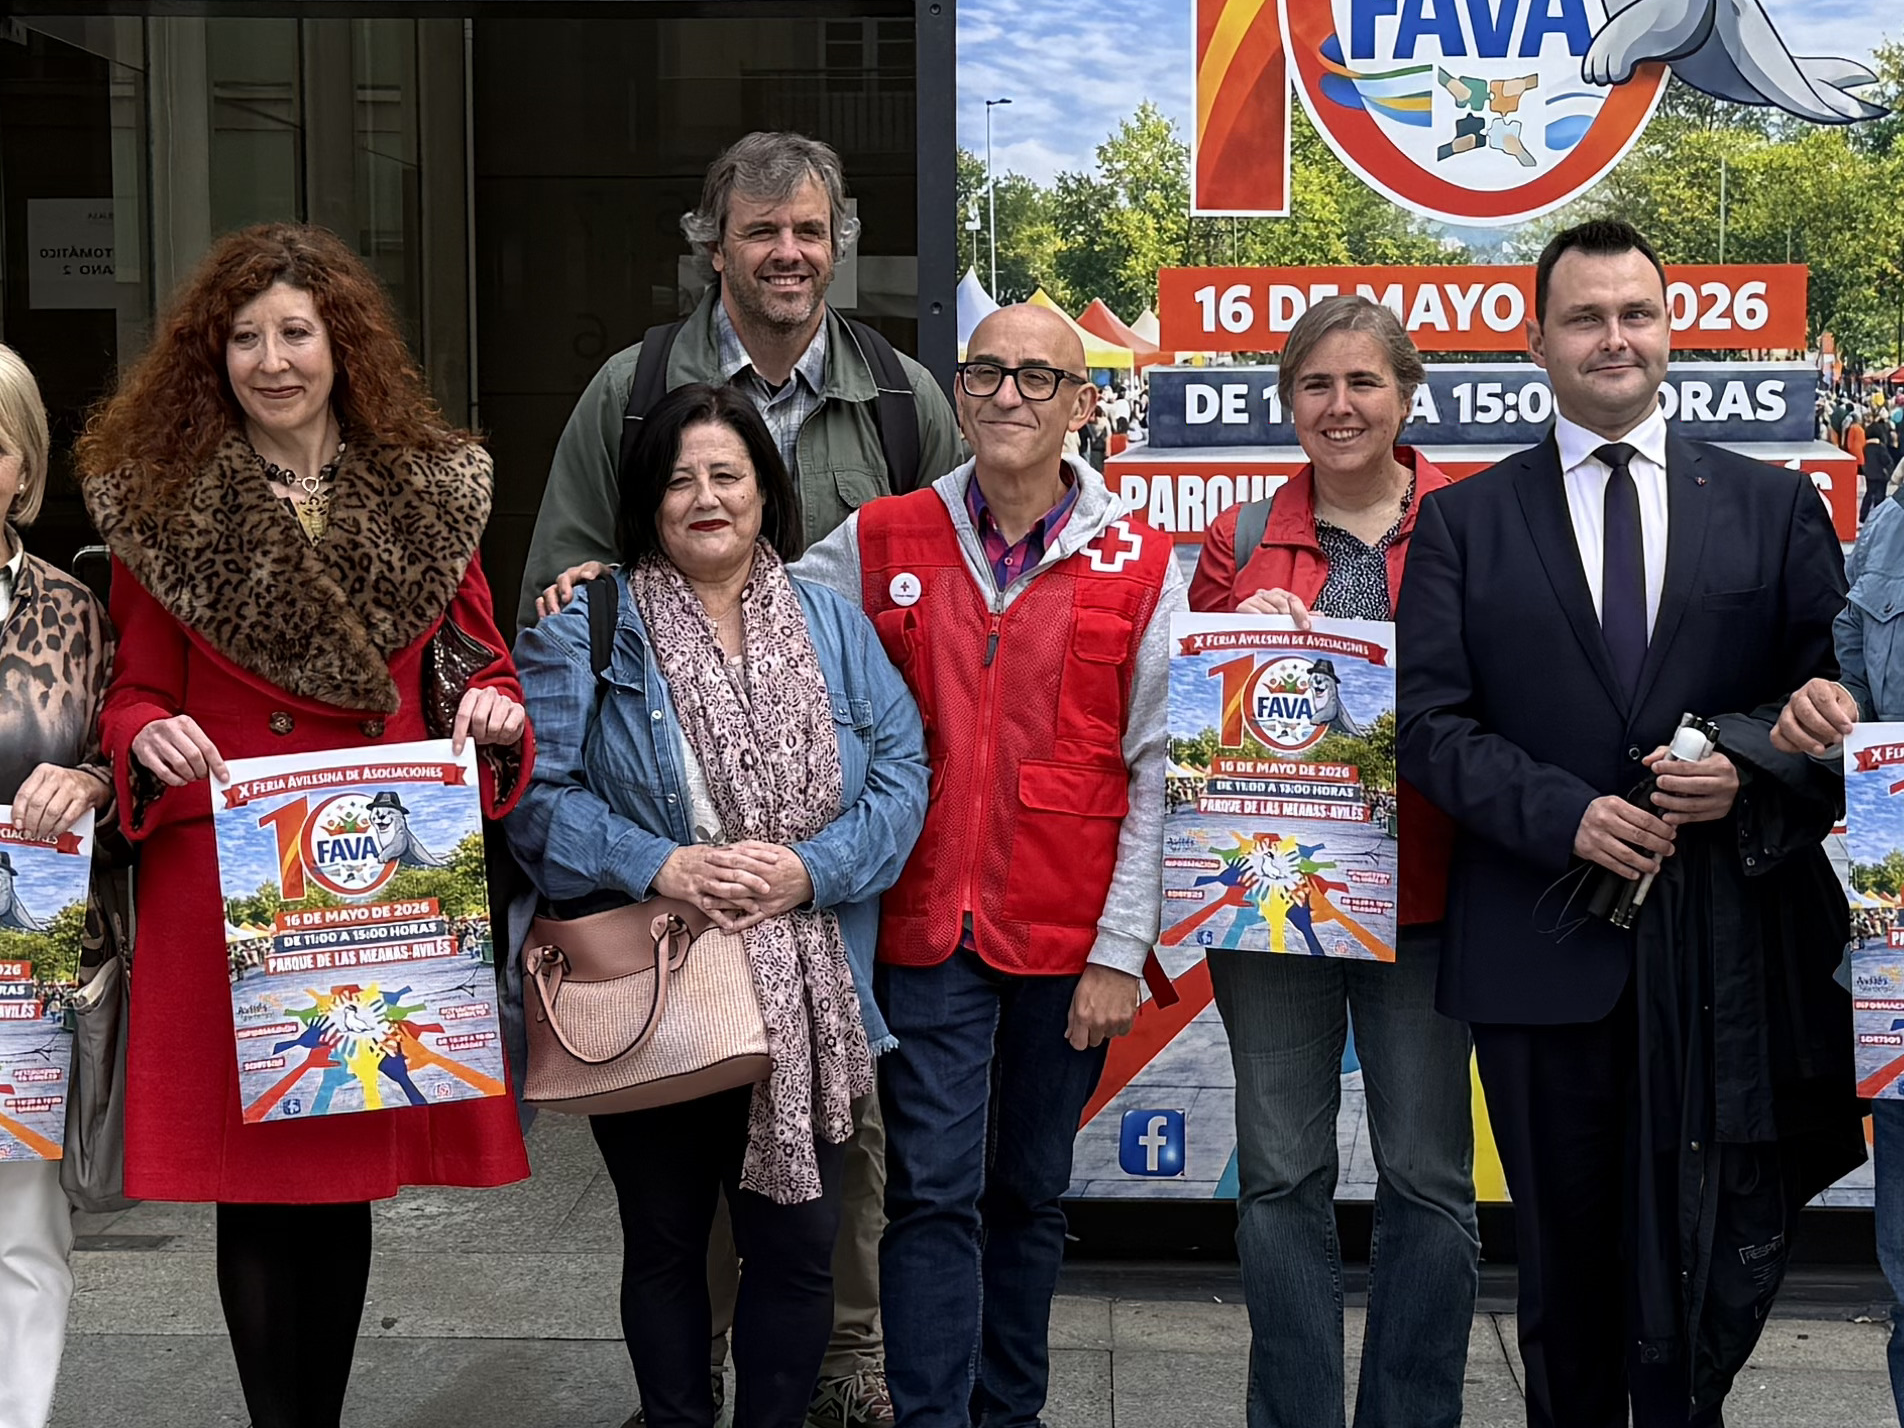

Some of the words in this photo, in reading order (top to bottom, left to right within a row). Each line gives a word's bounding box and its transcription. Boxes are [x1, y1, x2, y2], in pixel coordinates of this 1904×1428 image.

[1194, 283, 1255, 334] 16
[1268, 282, 1339, 333] D
[1666, 280, 1769, 332] 026
[1185, 383, 1250, 424] DE
[1404, 382, 1442, 424] A
[1451, 381, 1556, 424] 15:0
[1658, 379, 1787, 422] ORAS
[1257, 696, 1314, 720] FAVA
[316, 835, 379, 864] FAVA
